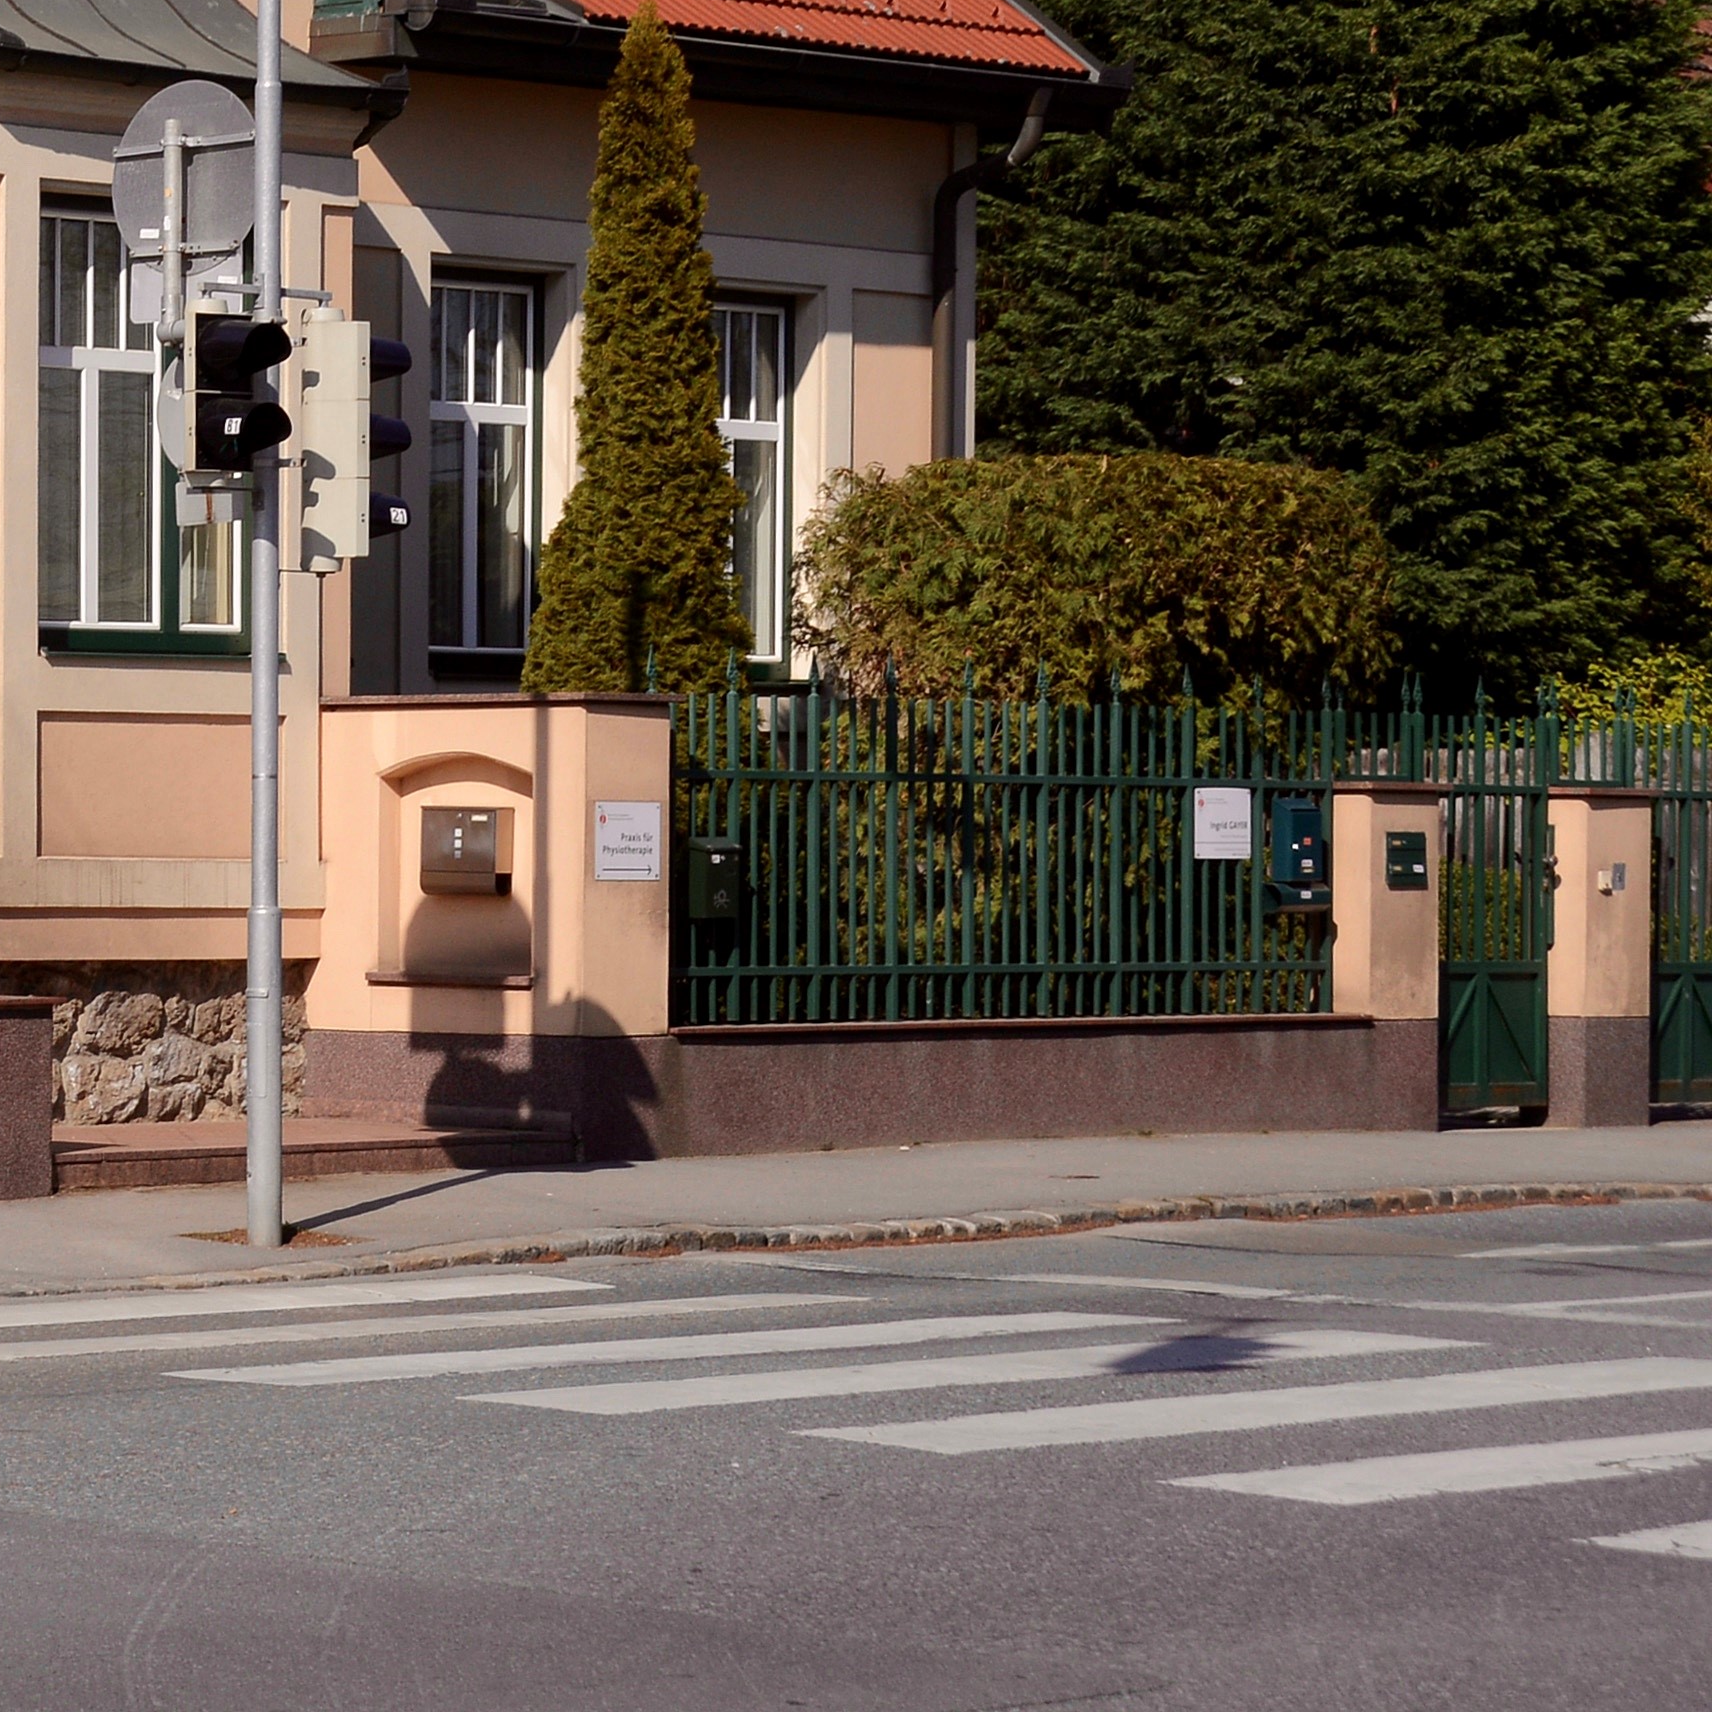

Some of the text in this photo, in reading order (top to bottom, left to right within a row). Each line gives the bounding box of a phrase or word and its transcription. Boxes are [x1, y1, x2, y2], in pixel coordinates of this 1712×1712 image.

[392, 508, 405, 523] 21
[620, 832, 642, 842] Praxis
[602, 844, 653, 857] Physiotherapie
